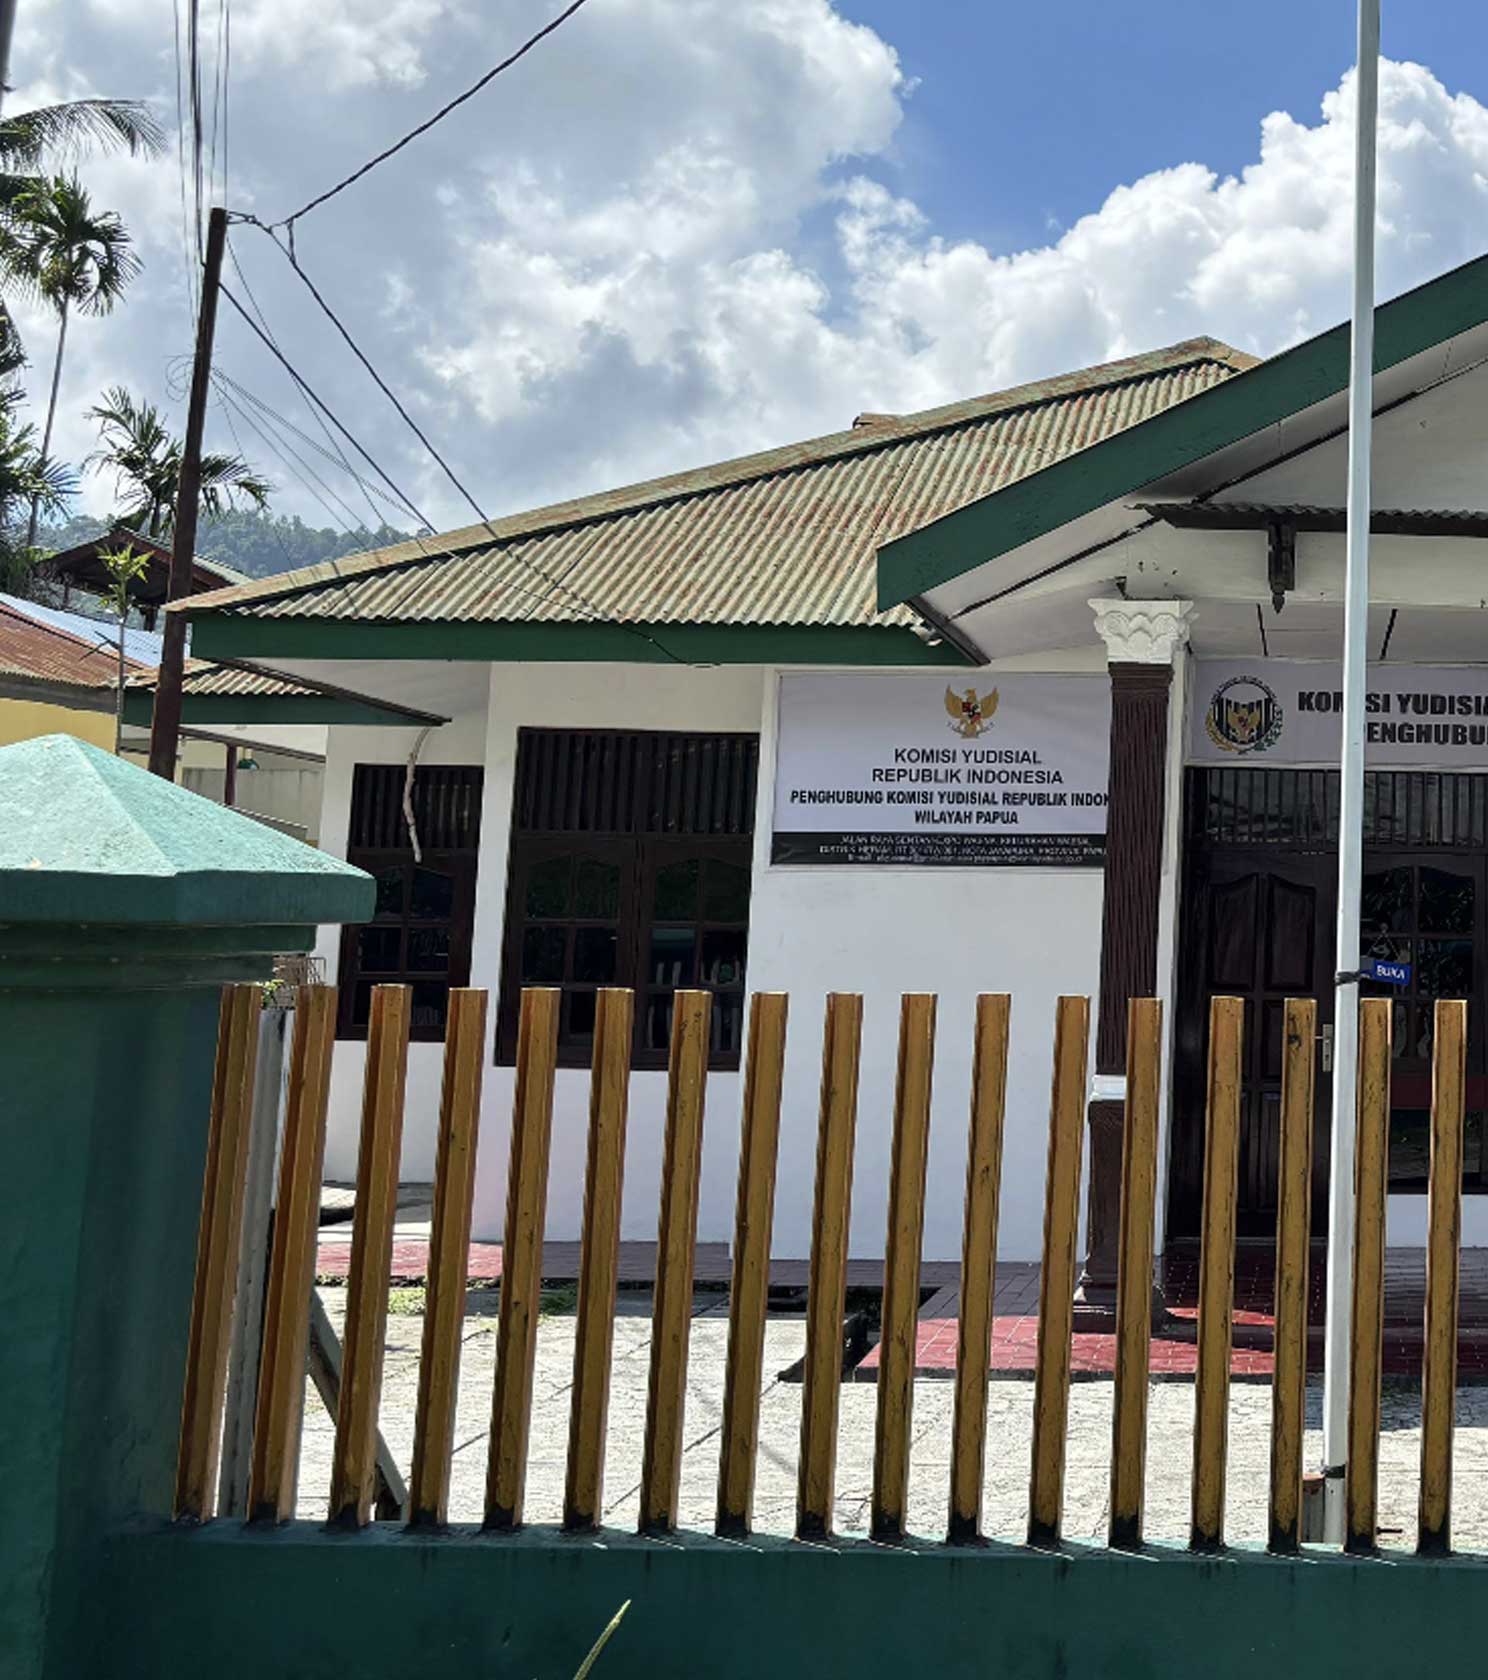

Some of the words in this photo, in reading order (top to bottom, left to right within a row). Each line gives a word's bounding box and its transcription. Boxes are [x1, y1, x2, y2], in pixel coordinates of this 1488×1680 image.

[1298, 691, 1391, 713] KOSI
[895, 748, 956, 764] KOMISI
[962, 750, 1042, 764] YUDISIAL
[872, 768, 961, 783] REPUBLIK
[967, 769, 1063, 784] INDONESIA
[790, 790, 883, 804] PENGHUBUNG
[886, 790, 933, 804] KOMISI
[938, 791, 998, 805] YUDISIAL
[1002, 792, 1067, 806] REPUBLIK
[1071, 793, 1110, 806] INDON
[915, 810, 973, 824] WILAYAH
[976, 811, 1018, 824] PAPUA
[1377, 965, 1405, 979] BUKA
